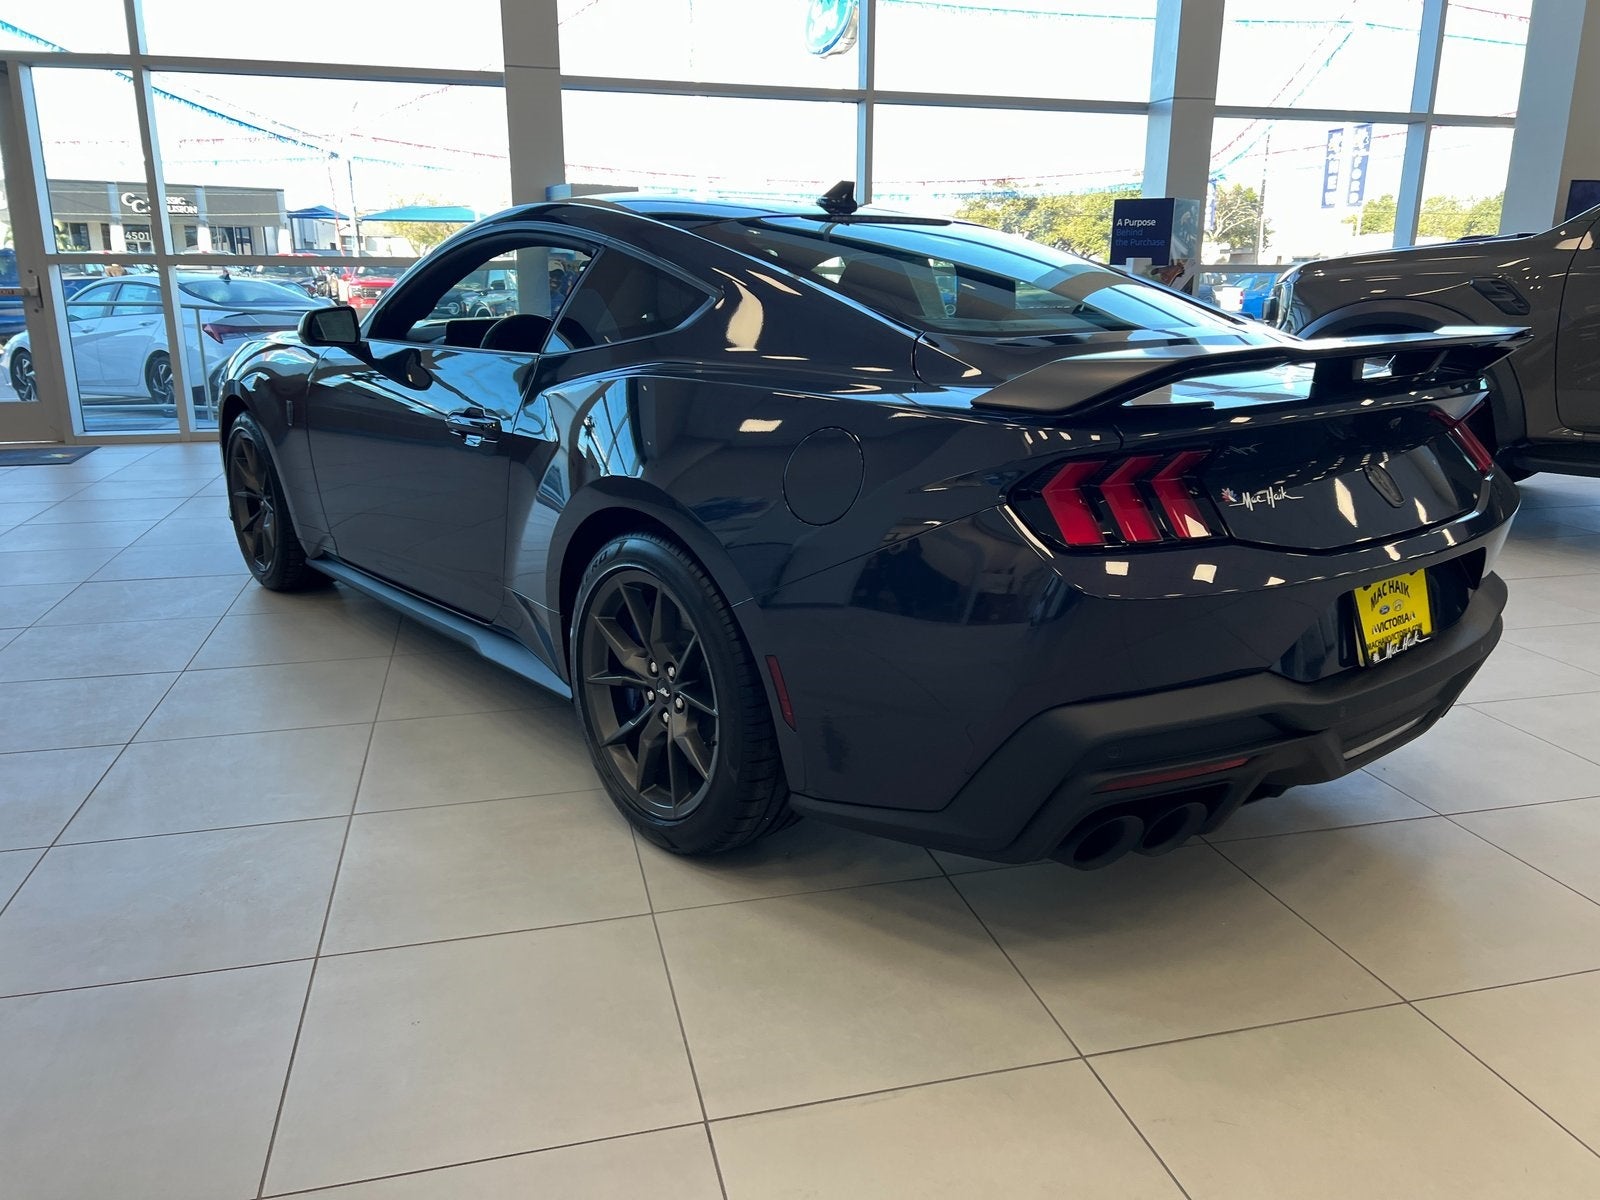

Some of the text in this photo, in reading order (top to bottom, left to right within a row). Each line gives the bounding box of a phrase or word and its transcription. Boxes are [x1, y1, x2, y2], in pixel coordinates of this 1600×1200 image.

[1116, 218, 1156, 227] A Purpose
[125, 231, 150, 241] 4501
[1116, 228, 1143, 236] Behind
[1116, 238, 1165, 246] the Purchase
[1370, 582, 1388, 612] MAC
[1388, 580, 1411, 599] HAIK
[1376, 612, 1411, 634] VICTORIA
